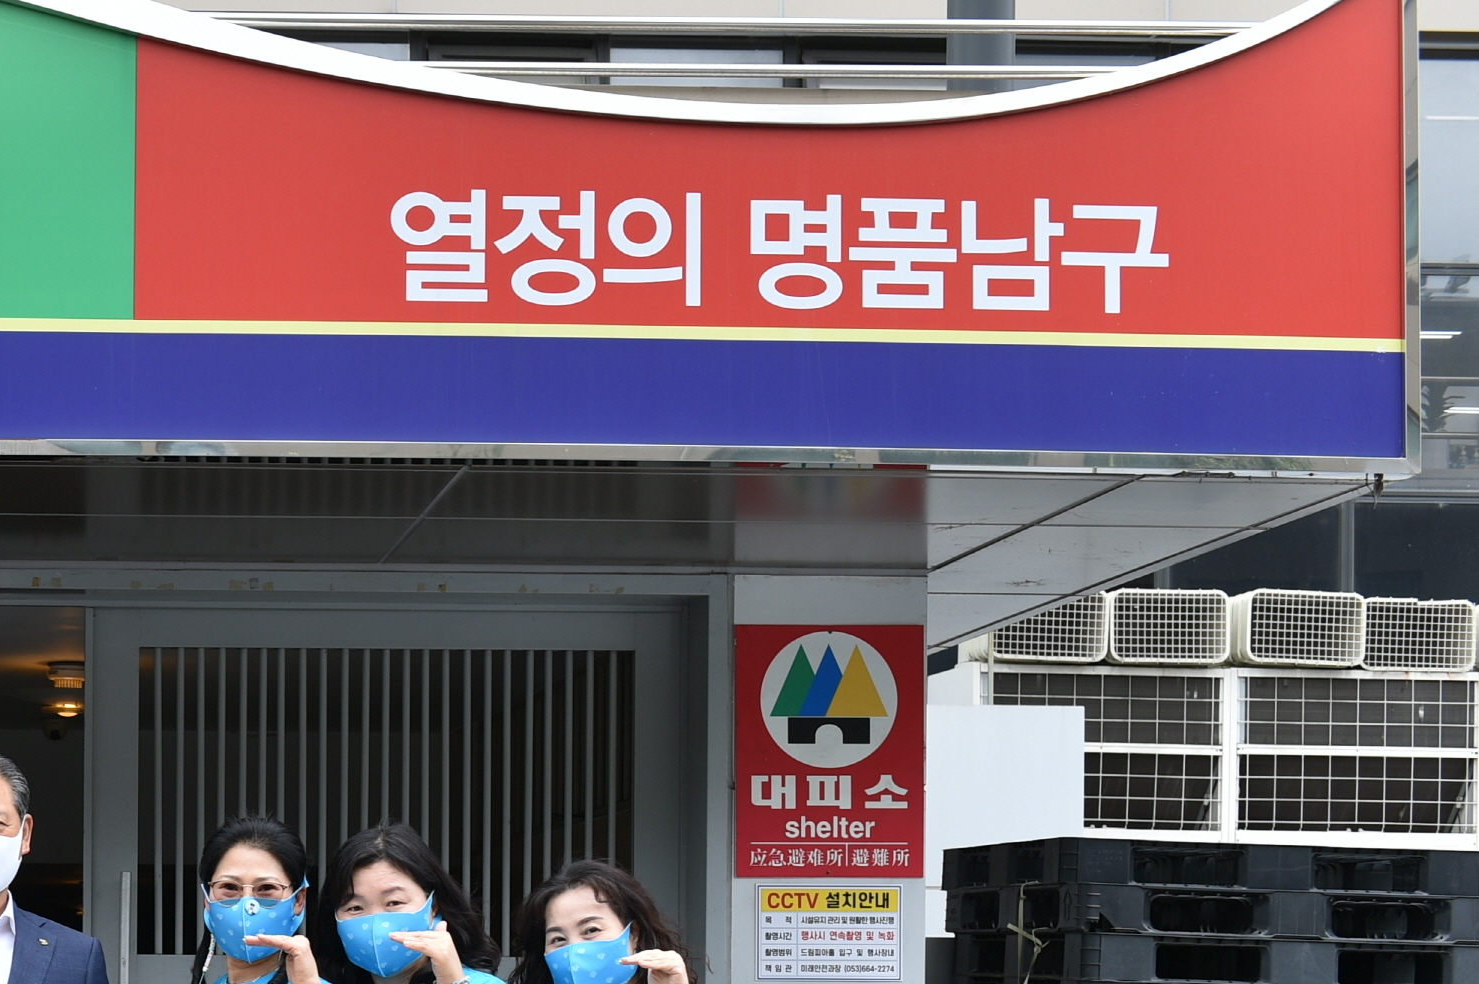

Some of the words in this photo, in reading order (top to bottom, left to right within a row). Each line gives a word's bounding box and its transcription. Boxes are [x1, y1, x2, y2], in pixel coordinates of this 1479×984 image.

[390, 189, 702, 307] 열정의
[750, 194, 1169, 314] 명품남구
[751, 774, 909, 809] 대피소
[785, 816, 875, 839] shelter
[749, 848, 843, 867] 应急避难所
[851, 848, 910, 867] 避難所
[767, 892, 819, 909] CCTV
[825, 891, 890, 909] 설치안내
[765, 932, 792, 941] 촬영시간
